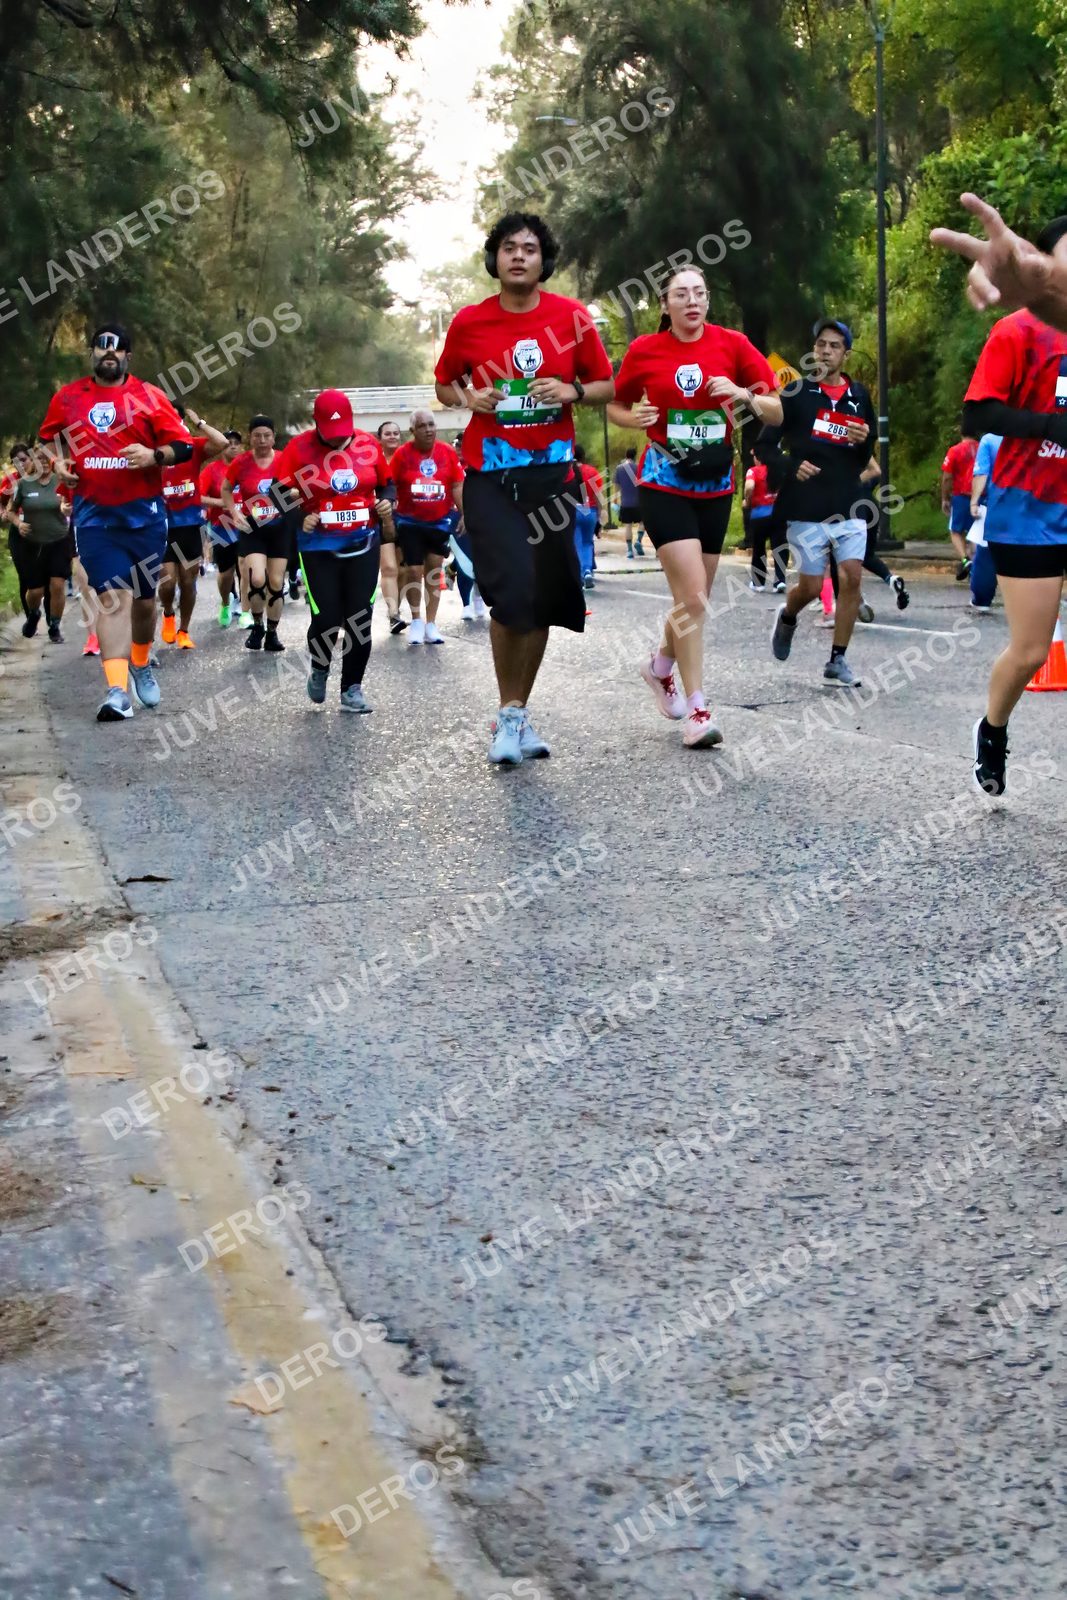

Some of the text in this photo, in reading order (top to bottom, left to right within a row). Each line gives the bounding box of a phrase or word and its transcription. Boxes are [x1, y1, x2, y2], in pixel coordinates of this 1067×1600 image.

[690, 426, 708, 438] 748
[827, 423, 849, 437] 2863
[336, 510, 357, 522] 1839
